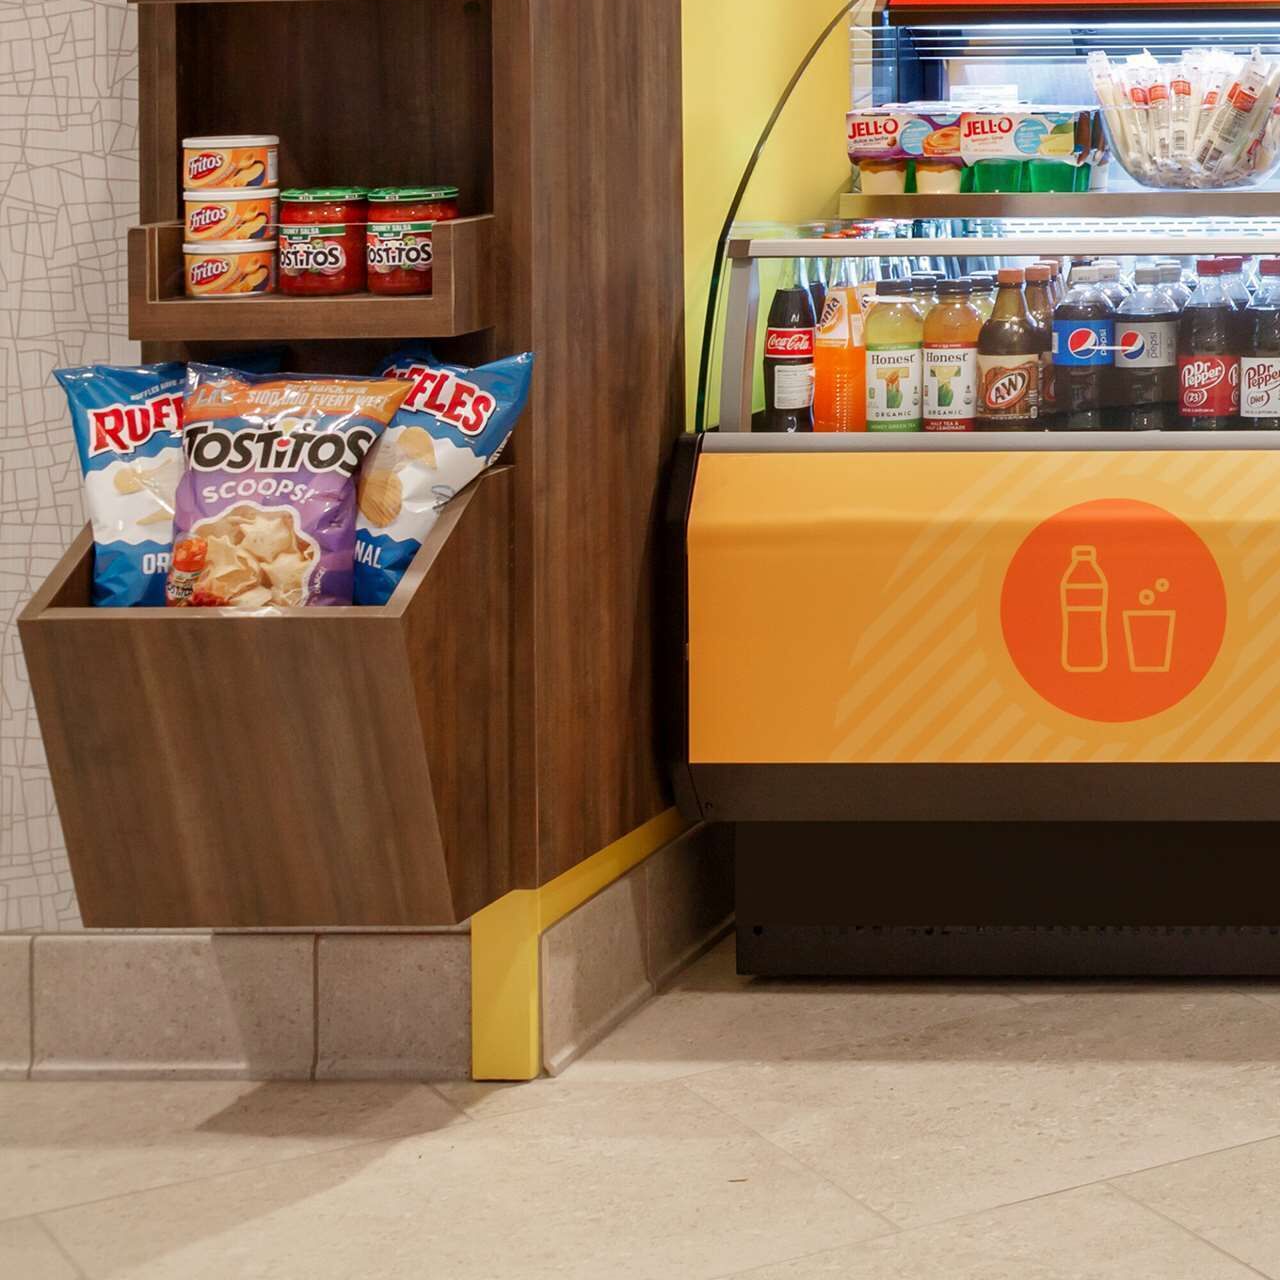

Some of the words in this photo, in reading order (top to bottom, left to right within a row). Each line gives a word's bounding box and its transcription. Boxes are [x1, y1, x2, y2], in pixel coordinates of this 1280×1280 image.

[281, 246, 341, 267] OSTITOS
[367, 242, 432, 265] OSTITOS
[819, 296, 840, 333] anta
[767, 333, 811, 351] Coca-Cola
[1150, 331, 1162, 359] pepsi
[871, 353, 916, 365] Honest
[926, 352, 969, 363] Honest
[1194, 358, 1211, 373] Dr
[1182, 362, 1223, 389] Pepper
[1254, 363, 1273, 375] Dr
[311, 393, 357, 407] EVERY
[1249, 393, 1266, 405] Diet
[875, 410, 912, 418] ORGANIC
[928, 409, 964, 417] ORGANIC
[91, 395, 184, 454] RUFF
[185, 422, 376, 477] TOSTITOS
[202, 478, 315, 504] SCOOPS!
